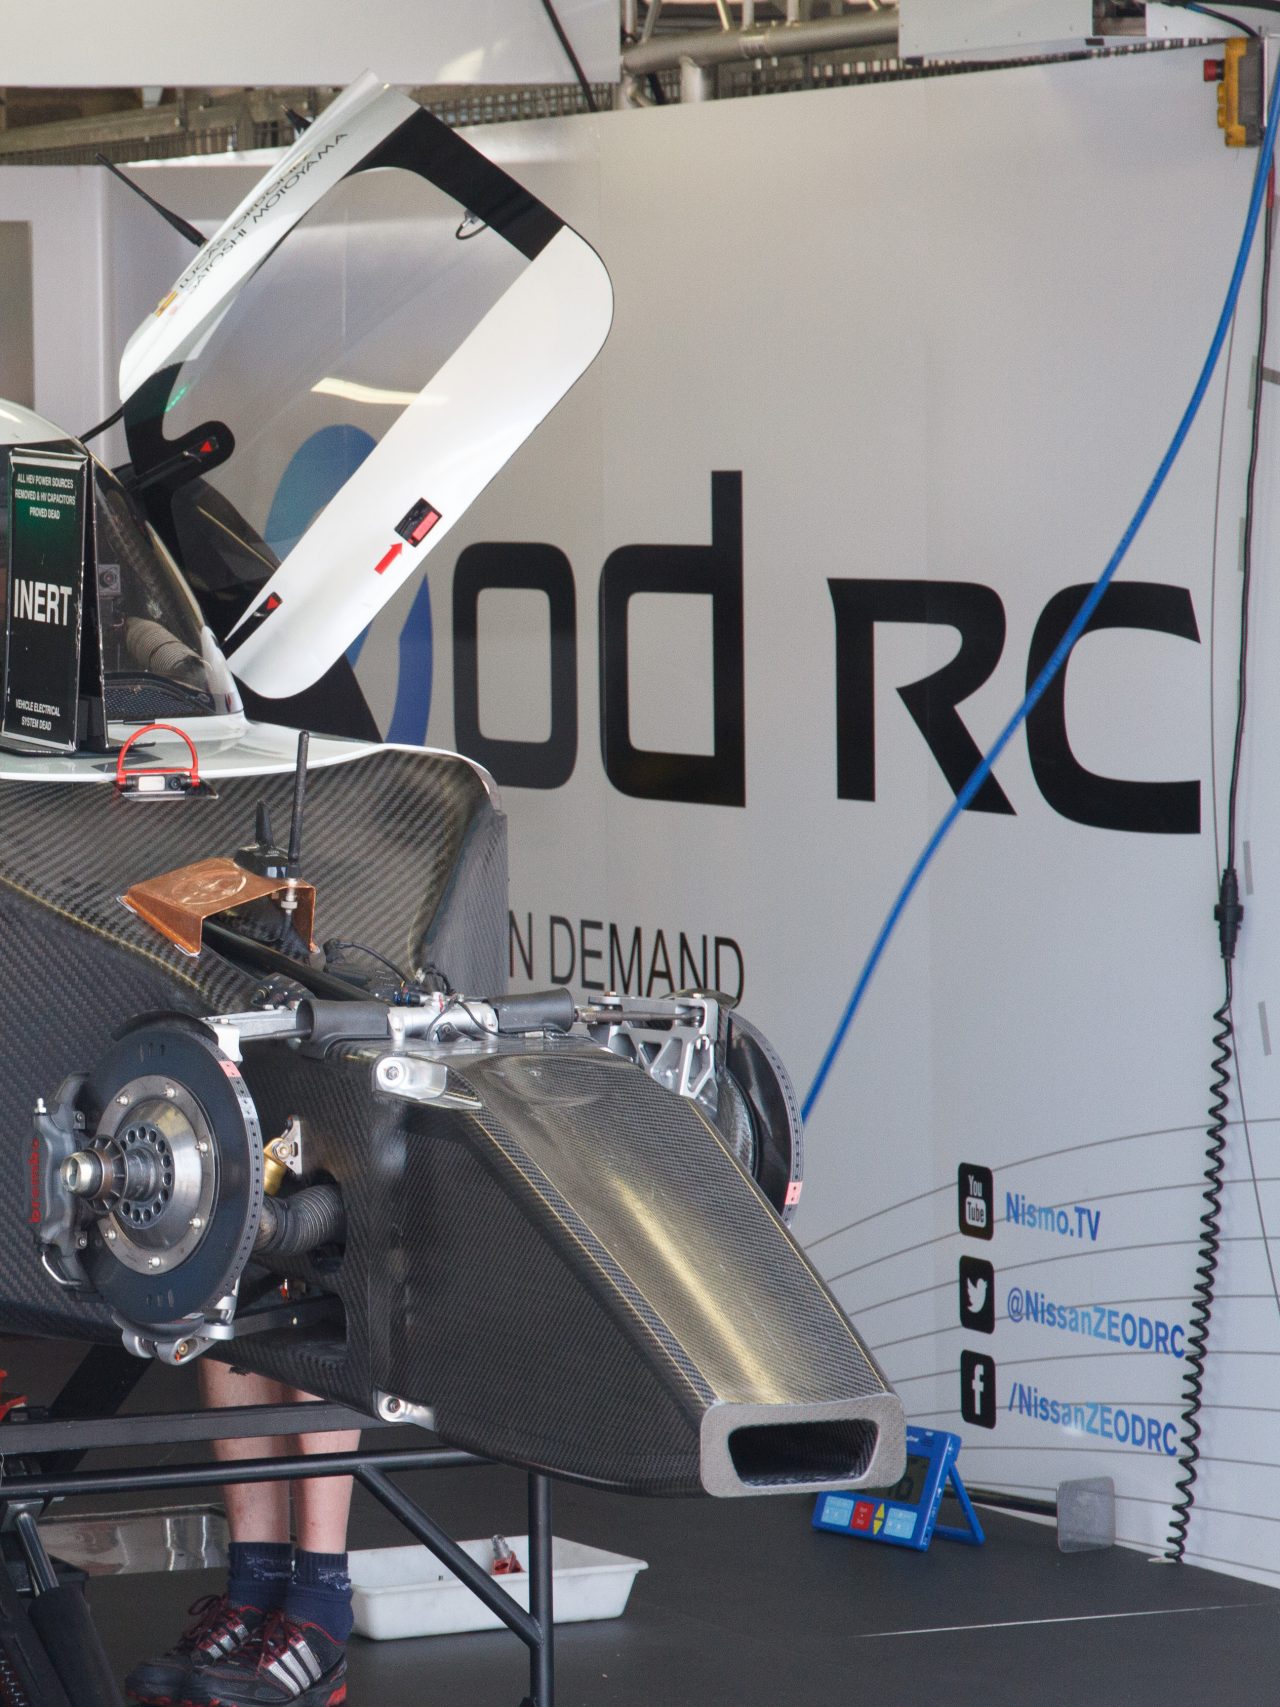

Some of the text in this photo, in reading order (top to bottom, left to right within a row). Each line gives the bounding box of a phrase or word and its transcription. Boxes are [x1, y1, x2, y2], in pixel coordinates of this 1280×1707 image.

[253, 133, 348, 223] MOTOYAMA
[15, 488, 36, 500] REMOVED
[48, 493, 76, 506] CAPACITORS
[17, 473, 26, 484] ALL
[36, 475, 52, 486] POWER
[52, 477, 74, 488] SOURCES
[30, 506, 60, 520] PROVED DEAD
[13, 578, 73, 627] INERT
[15, 698, 61, 717] VEHICLE ELECTRICAL
[21, 715, 52, 731] SYSTEM DEAD
[826, 578, 1202, 835] RC
[508, 910, 745, 1008] N DEMAND
[28, 1138, 41, 1223] brembo
[968, 1175, 983, 1198] You
[967, 1202, 985, 1223] Tube
[1005, 1191, 1101, 1241] Nismo.TV
[1007, 1287, 1186, 1358] @NissanZEODRC
[1008, 1382, 1178, 1456] /NissanZEODRC
